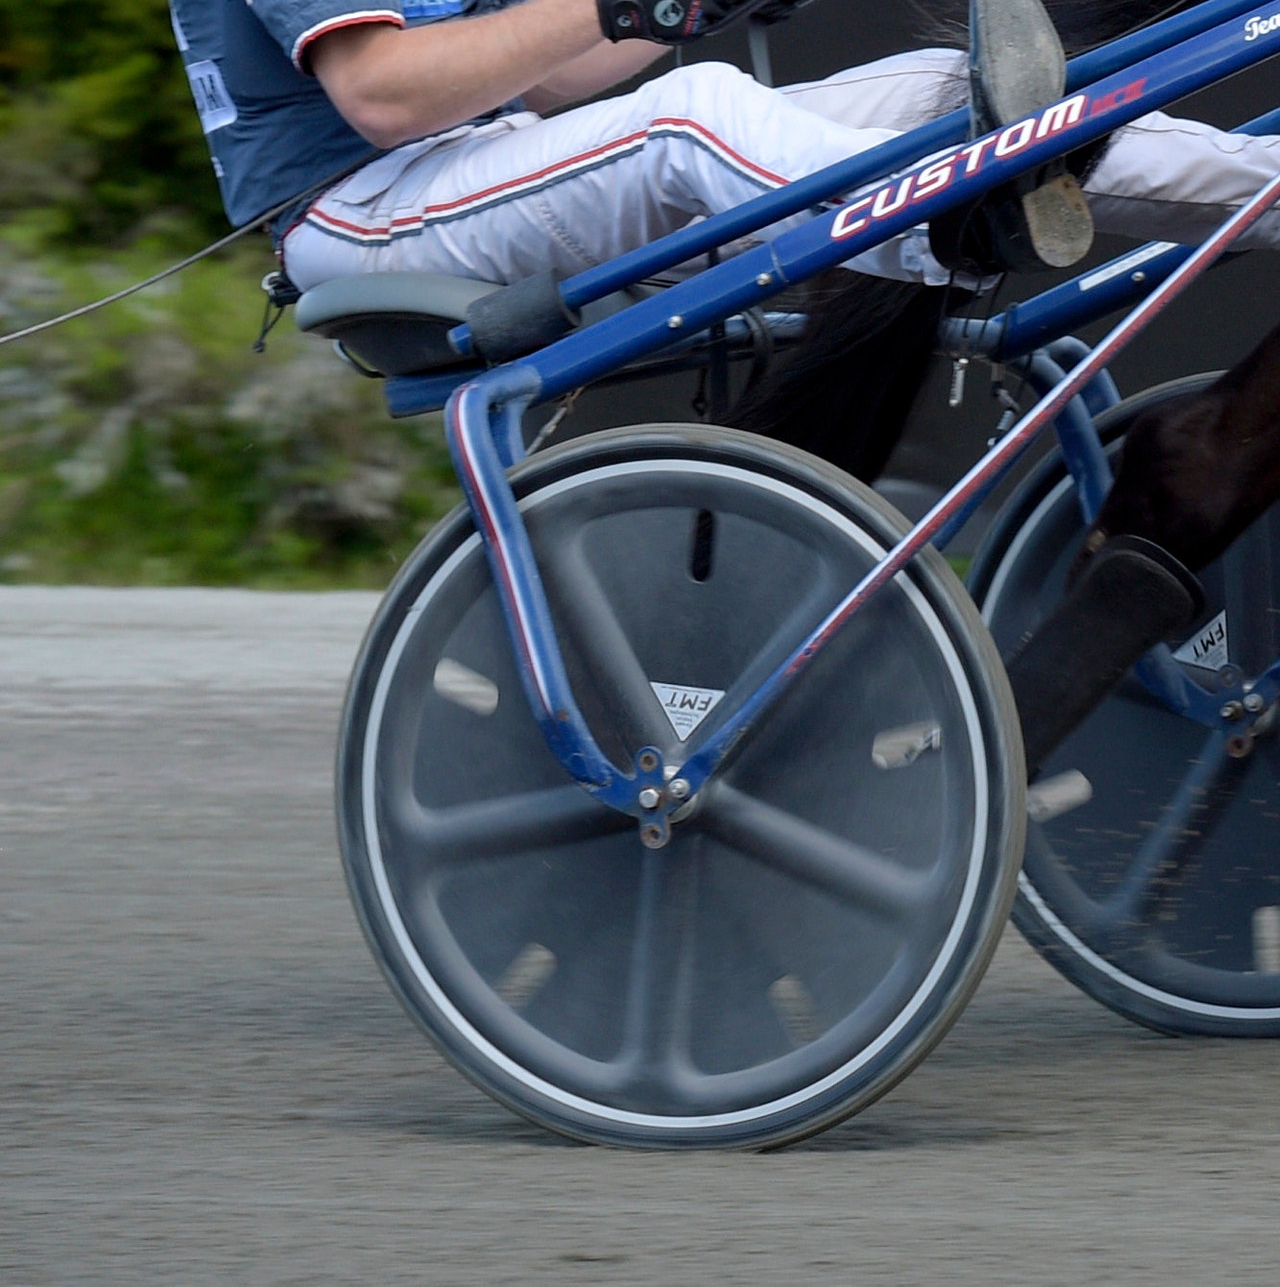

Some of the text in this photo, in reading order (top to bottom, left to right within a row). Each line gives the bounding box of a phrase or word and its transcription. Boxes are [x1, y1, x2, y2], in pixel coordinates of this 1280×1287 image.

[830, 93, 1088, 242] CUSTOM
[1191, 621, 1225, 664] FMT
[663, 690, 714, 712] FMT
